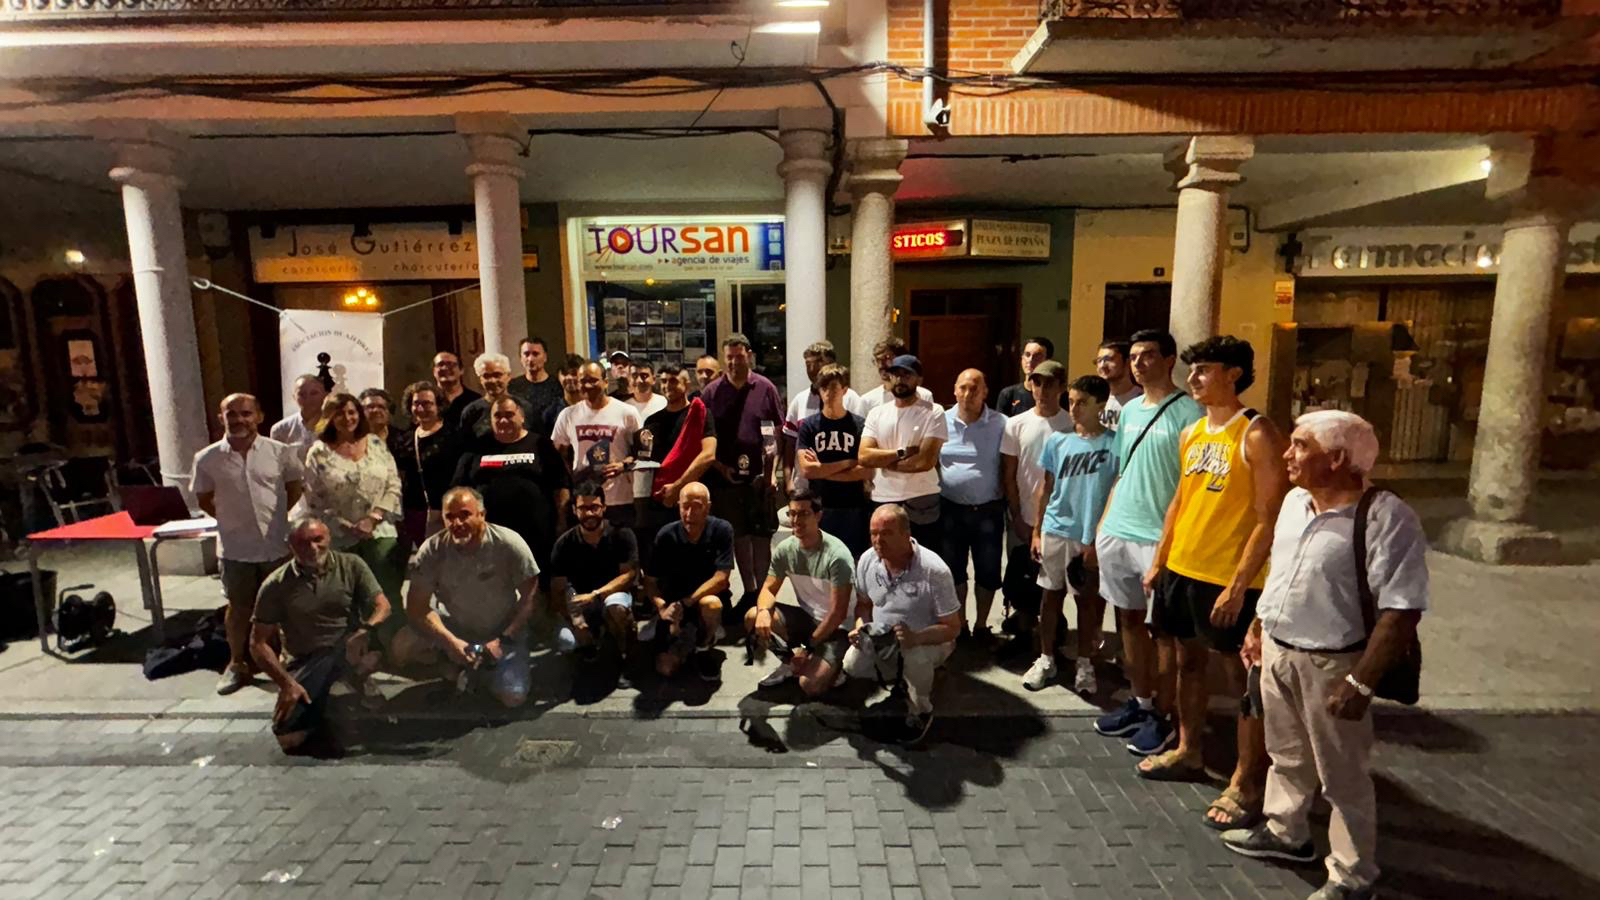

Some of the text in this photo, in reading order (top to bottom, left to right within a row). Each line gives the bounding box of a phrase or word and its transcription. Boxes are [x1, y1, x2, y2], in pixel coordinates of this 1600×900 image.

[288, 230, 337, 257] José
[894, 232, 944, 248] STICOS
[672, 256, 750, 266] agencia de viajes
[814, 430, 855, 453] GAP
[1058, 449, 1110, 480] NIKE
